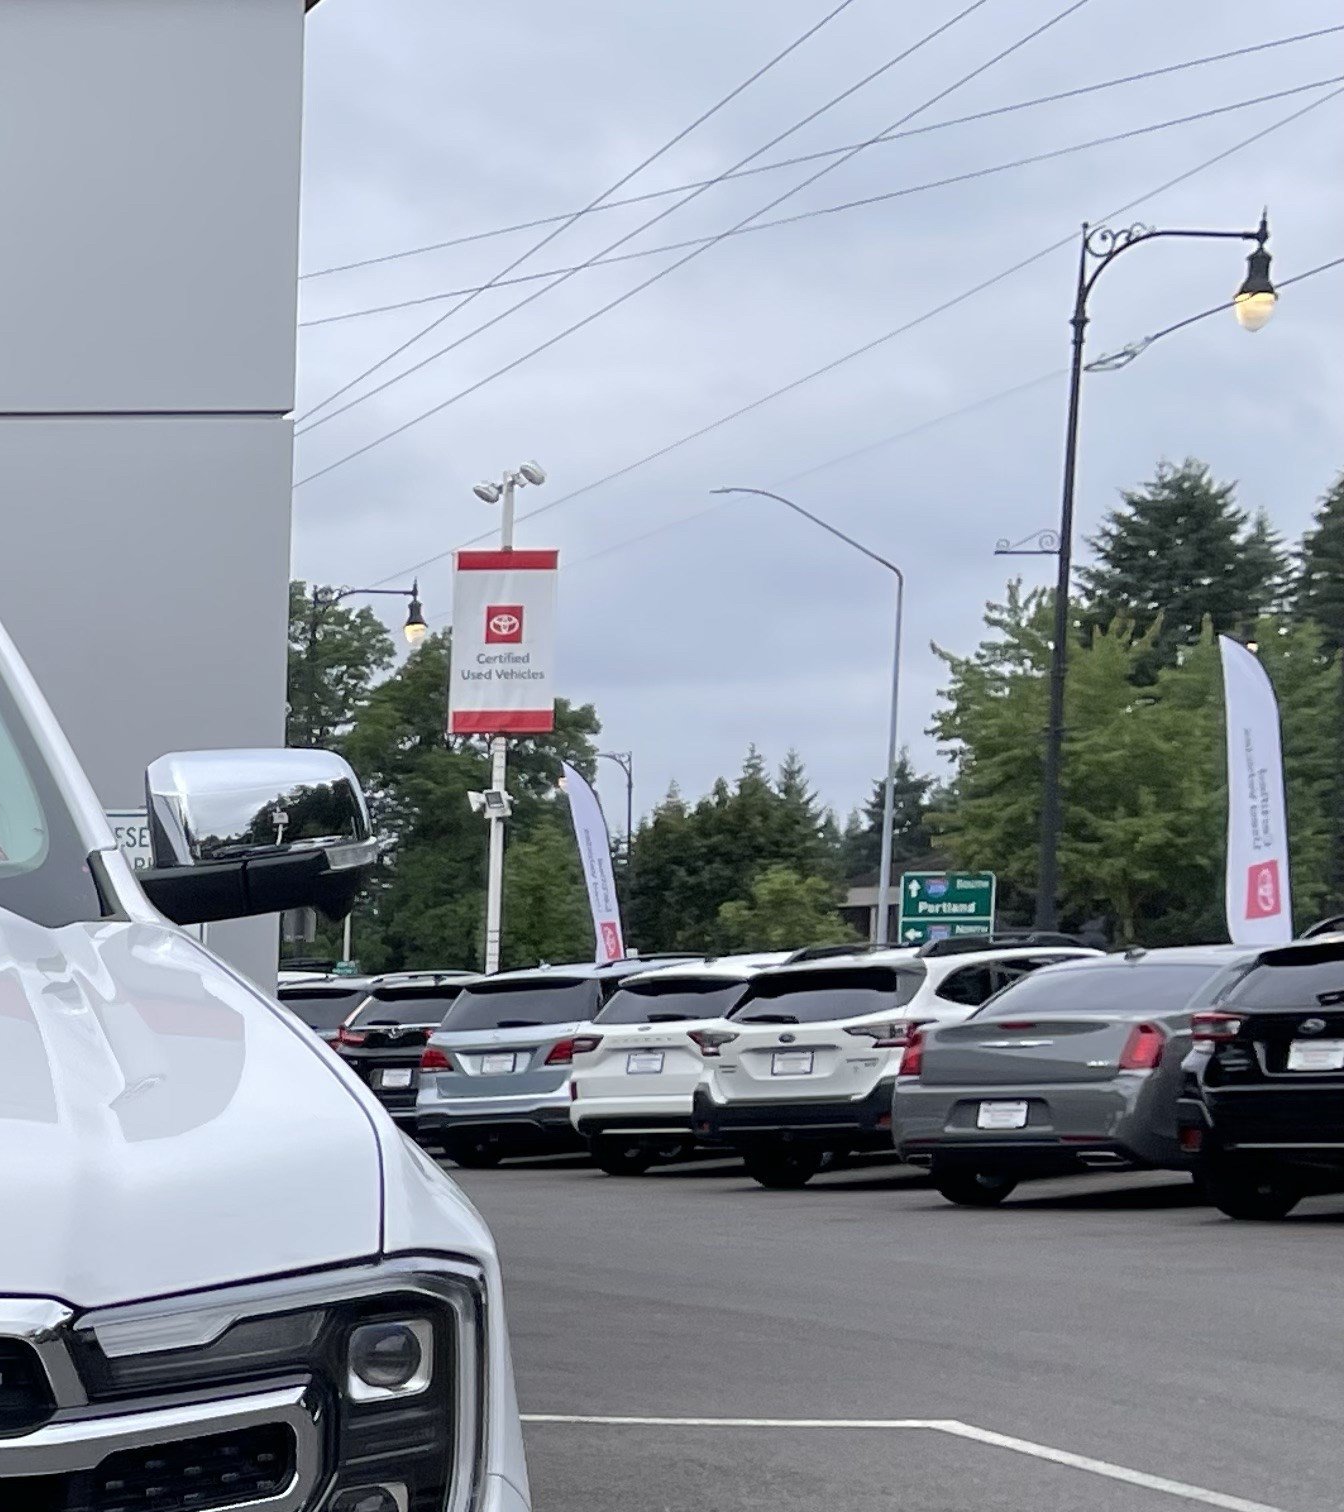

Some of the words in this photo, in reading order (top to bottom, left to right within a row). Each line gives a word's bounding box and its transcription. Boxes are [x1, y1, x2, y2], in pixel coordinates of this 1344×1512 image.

[476, 652, 530, 664] Certified
[461, 669, 492, 680] Used
[495, 669, 545, 680] Vehicles
[918, 901, 976, 914] Portland
